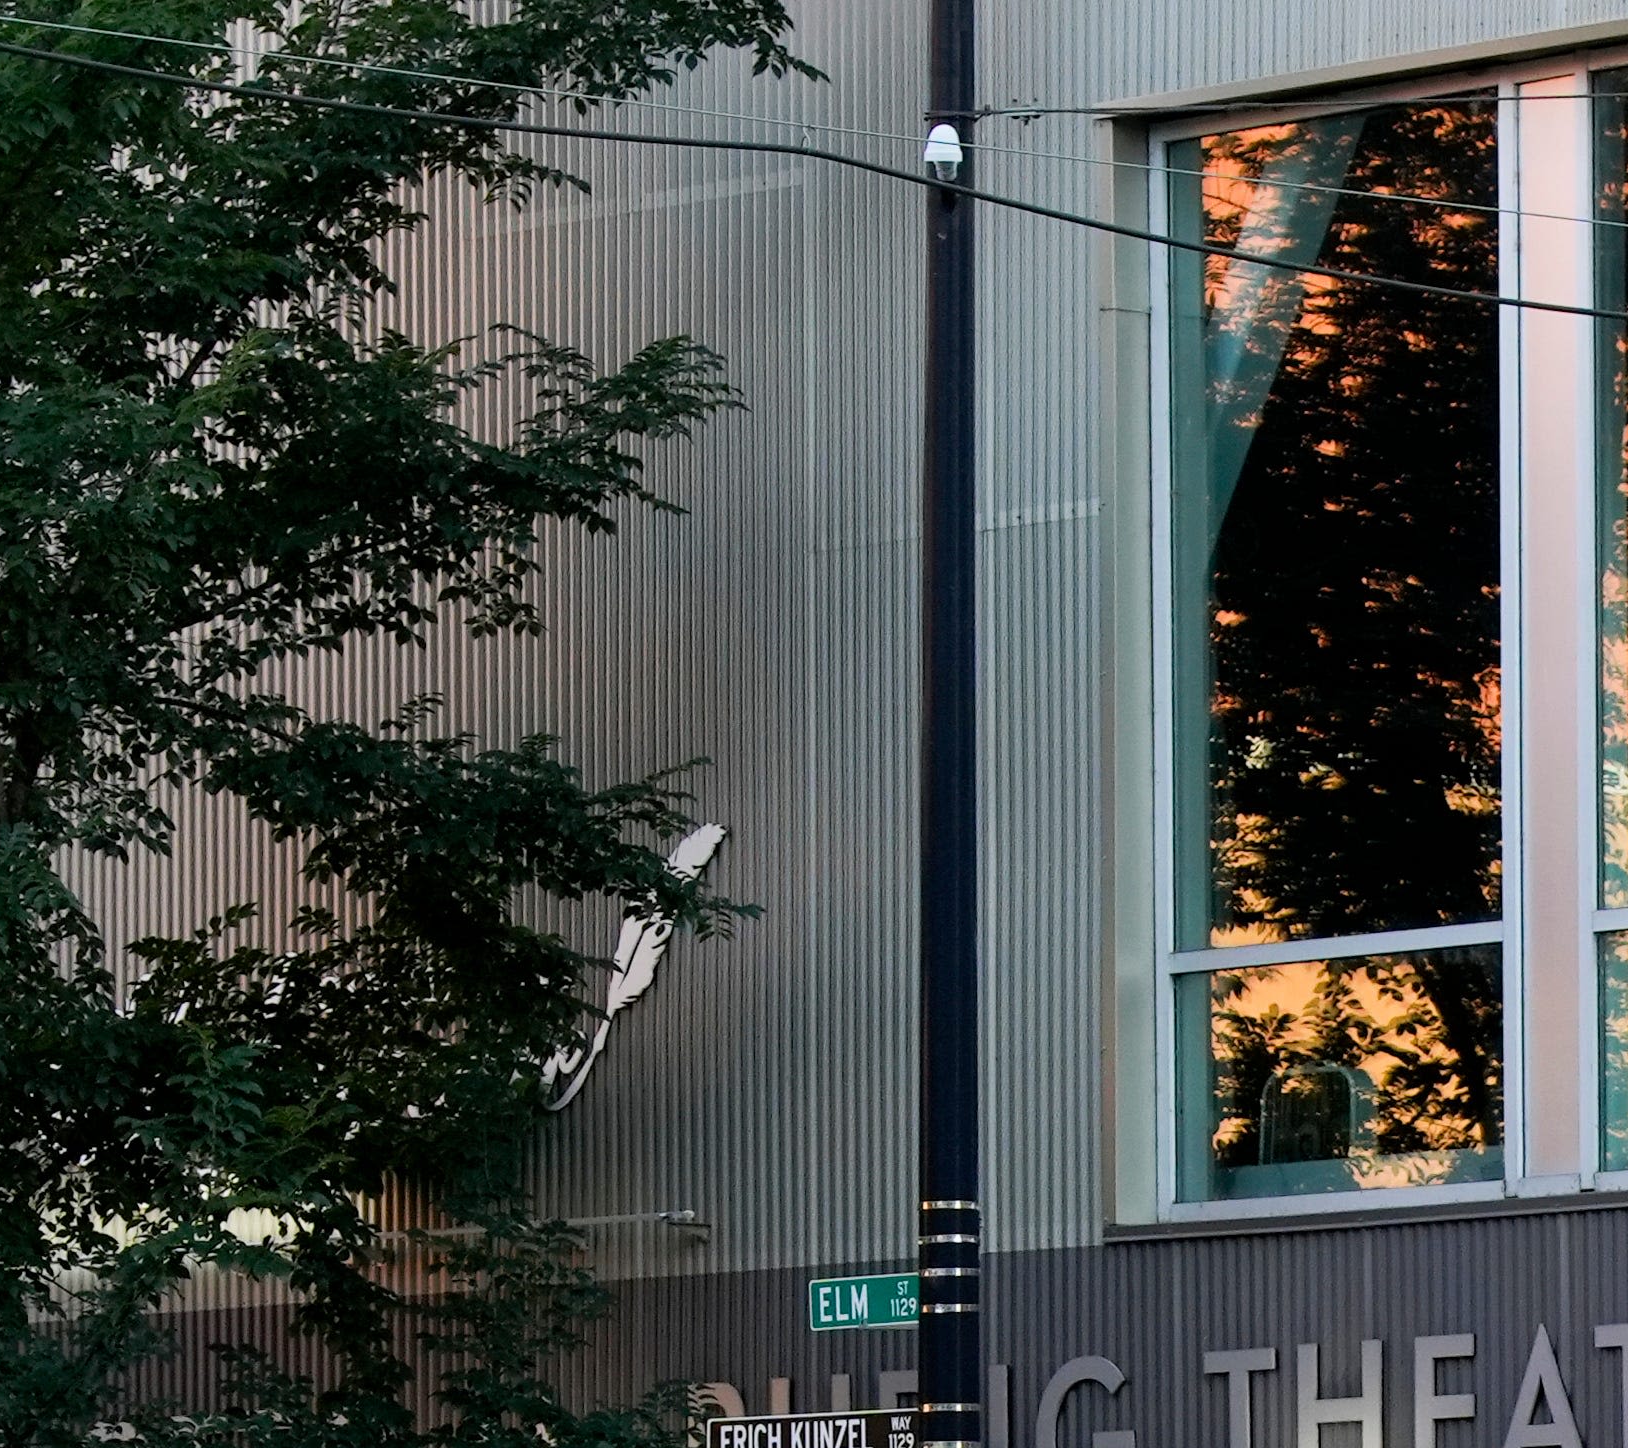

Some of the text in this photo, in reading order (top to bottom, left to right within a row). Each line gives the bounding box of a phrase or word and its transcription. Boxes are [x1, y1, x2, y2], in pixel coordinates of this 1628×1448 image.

[819, 1280, 909, 1322] ELM ST
[890, 1297, 917, 1317] 1129
[891, 1416, 911, 1431] WAY
